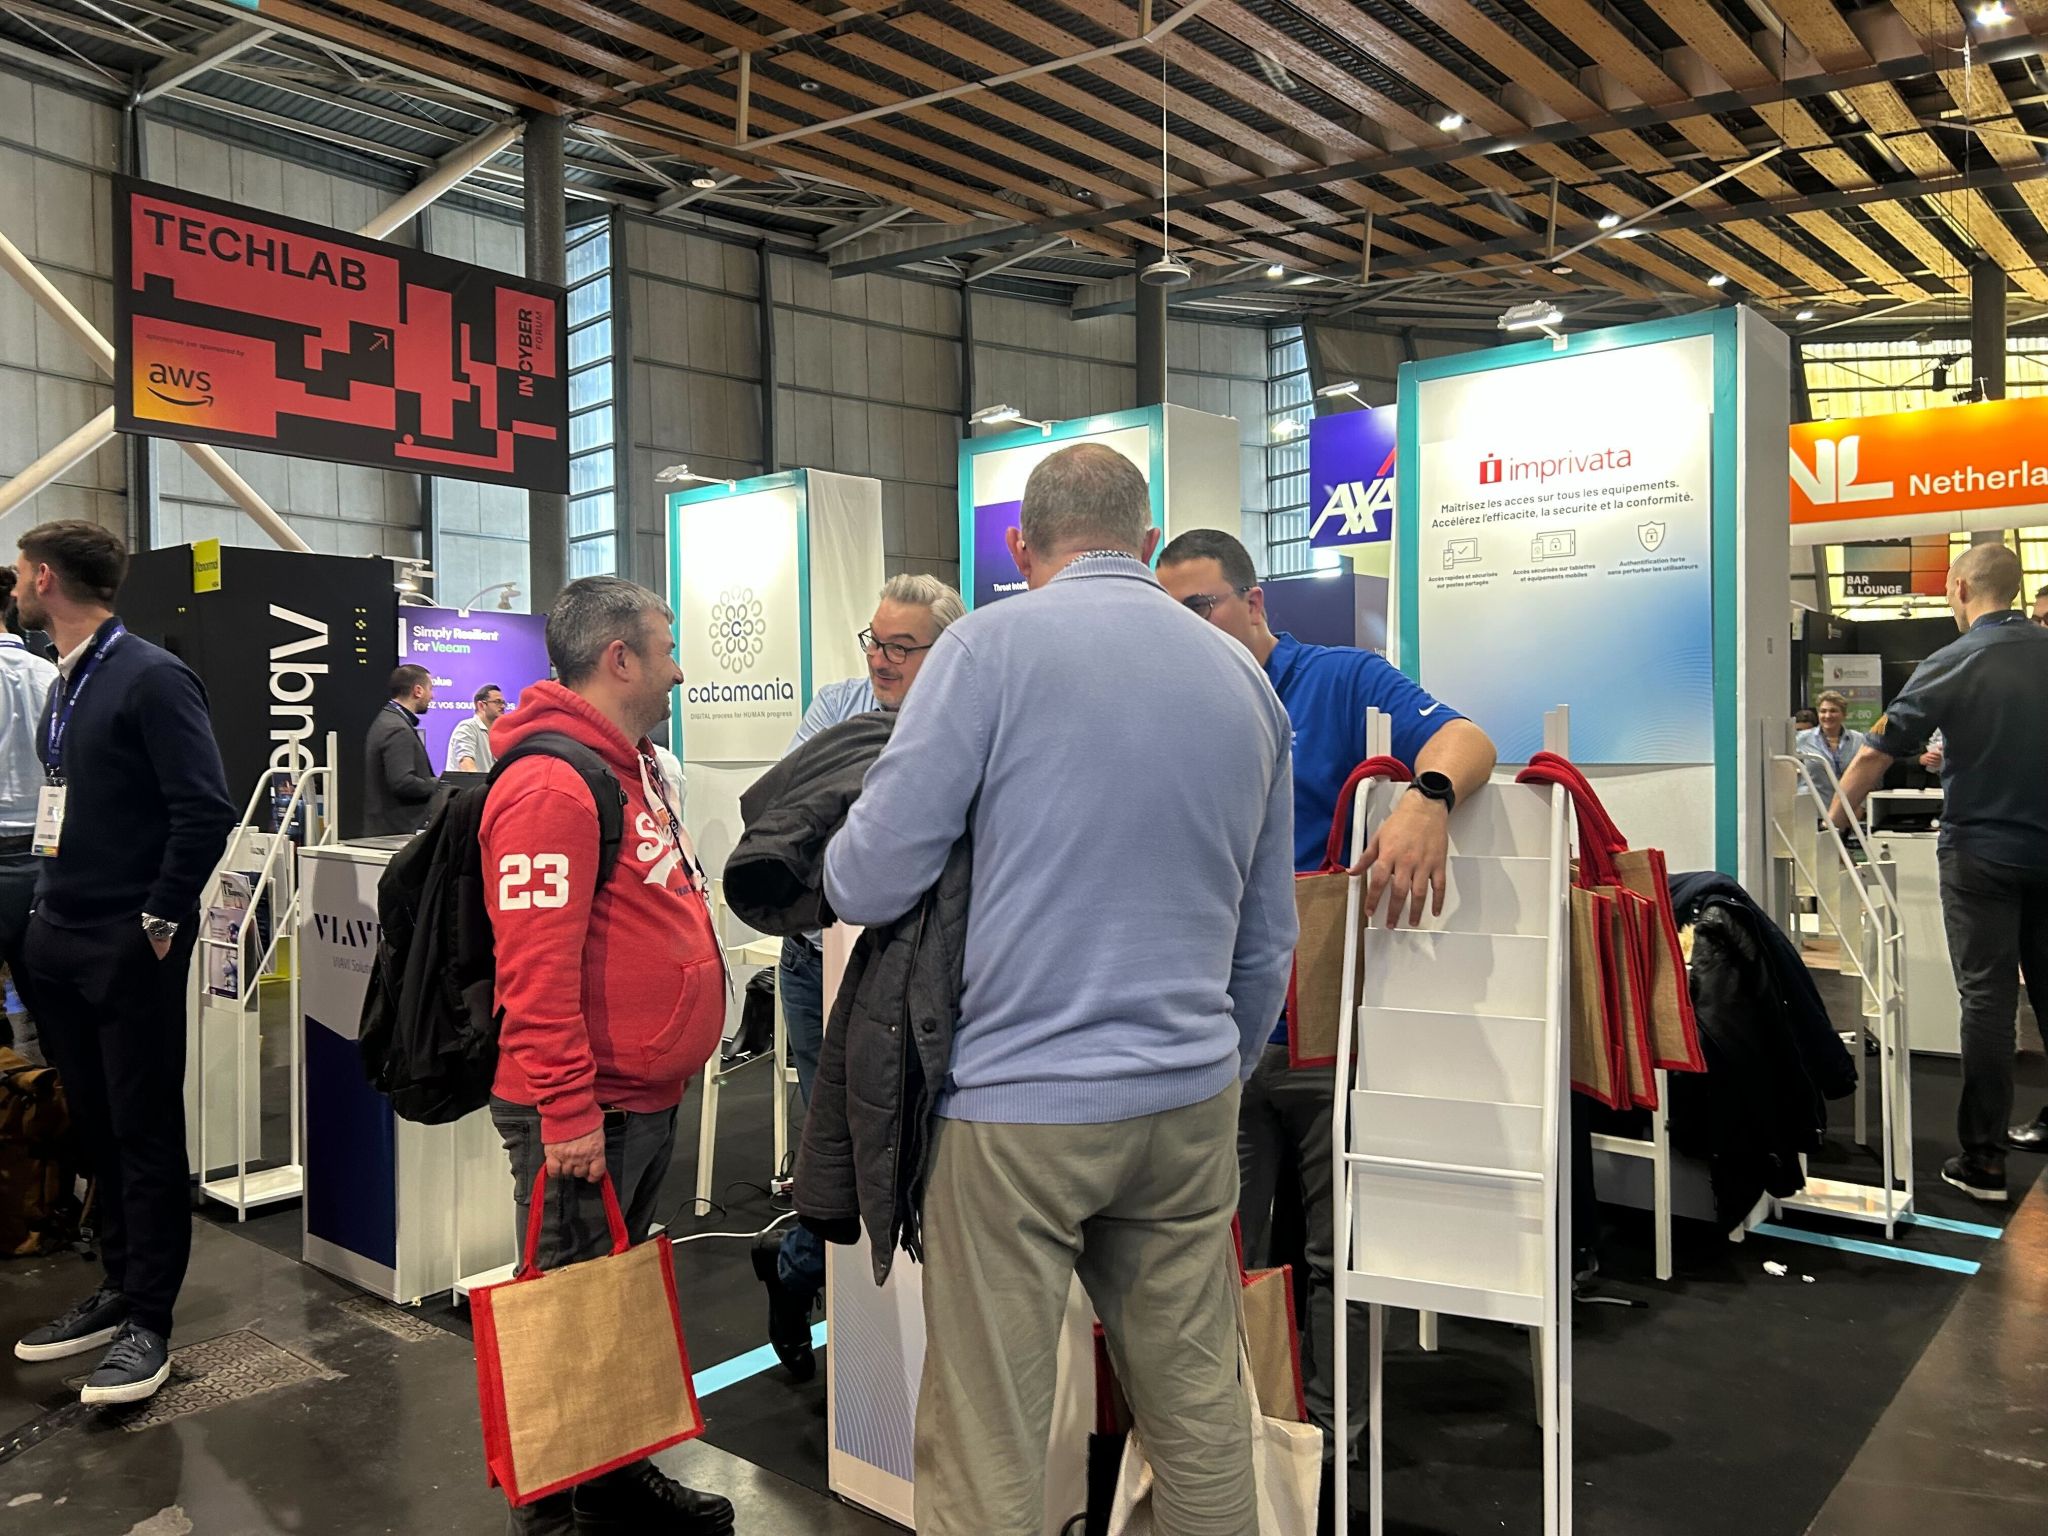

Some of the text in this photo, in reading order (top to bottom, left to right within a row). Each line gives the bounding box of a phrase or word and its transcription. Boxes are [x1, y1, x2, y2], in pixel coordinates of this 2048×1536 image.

[143, 208, 367, 291] TECHLAB
[535, 311, 543, 350] FORUM
[149, 363, 212, 392] aws
[1510, 447, 1632, 484] imprivata
[1909, 460, 2048, 496] Netherla
[1309, 477, 1394, 539] AXA
[1488, 499, 1502, 508] les
[1537, 494, 1554, 503] sur
[1557, 490, 1581, 500] tous
[1583, 488, 1599, 497] les
[1541, 507, 1550, 516] la
[1600, 501, 1611, 510] et
[1613, 500, 1624, 509] la
[1847, 575, 1869, 585] BAR
[1847, 584, 1902, 595] & LOUNGE
[413, 626, 499, 641] Simply Resilient
[413, 640, 471, 653] for Veeam
[688, 677, 794, 703] catamania
[438, 701, 454, 709] vos
[767, 711, 792, 719] progress
[499, 853, 569, 910] 23
